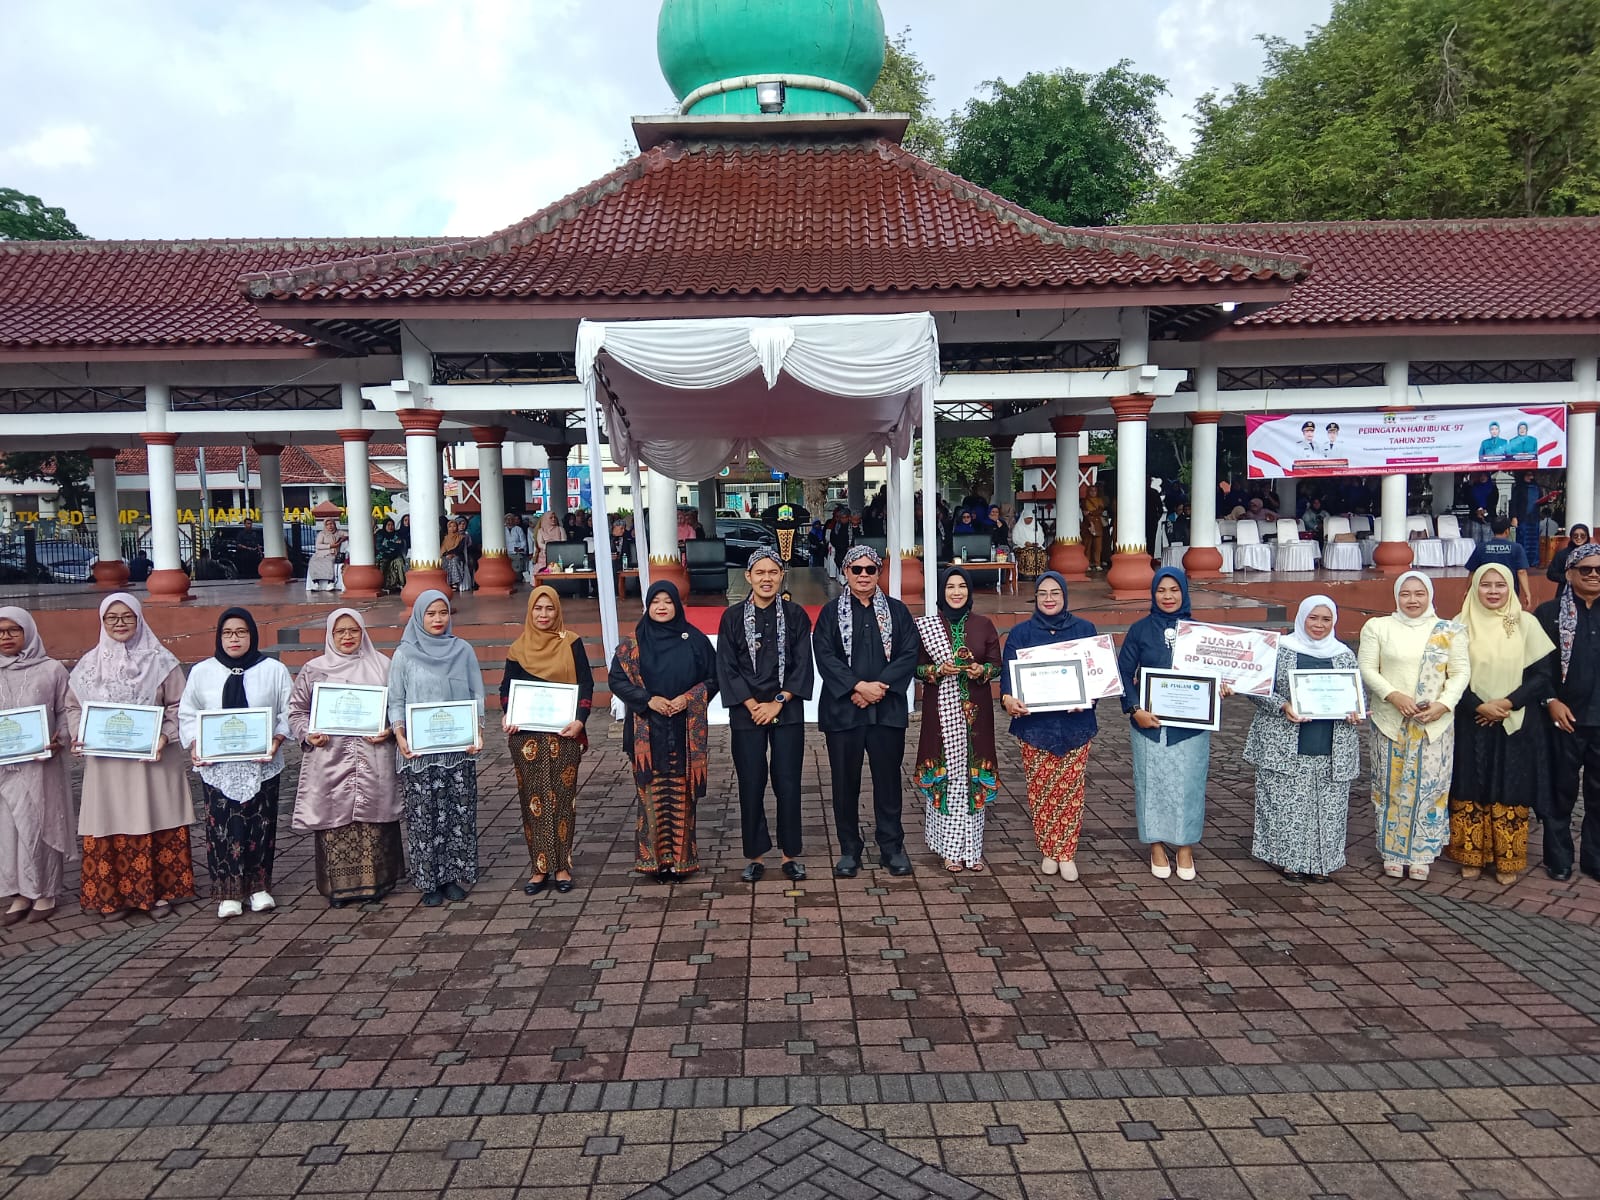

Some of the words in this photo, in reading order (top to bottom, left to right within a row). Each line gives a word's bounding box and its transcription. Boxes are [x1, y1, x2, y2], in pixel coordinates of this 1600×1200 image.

[1359, 426, 1406, 435] PERINGATAN
[1427, 425, 1439, 433] IBU
[16, 511, 39, 522] TK
[57, 509, 83, 525] SD
[1200, 636, 1243, 649] JUARA
[1184, 654, 1200, 663] RP
[1202, 656, 1263, 671] 10.000.000
